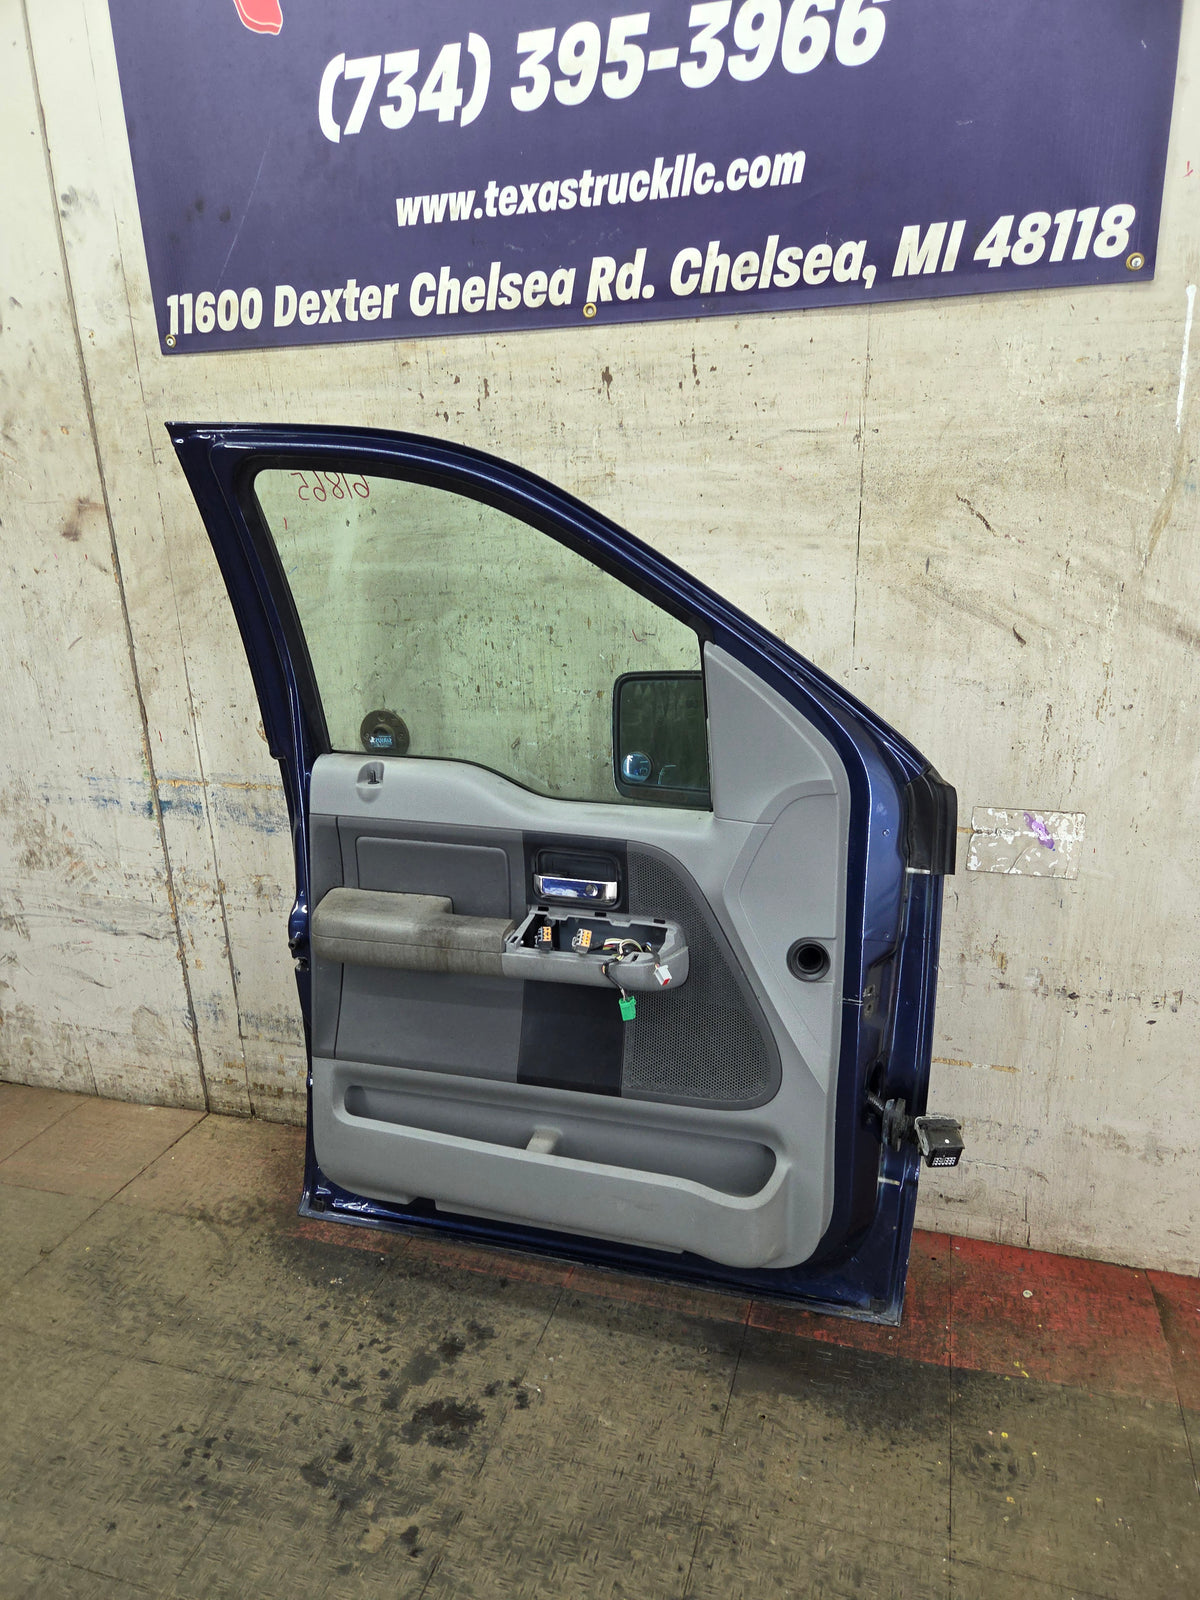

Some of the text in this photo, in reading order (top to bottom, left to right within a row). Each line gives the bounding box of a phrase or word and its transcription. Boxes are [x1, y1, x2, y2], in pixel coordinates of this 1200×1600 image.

[318, 0, 891, 143] (734) 395-3966
[396, 150, 806, 227] www.texastruckllc.com
[167, 203, 1136, 336] 11600 Dexter Chelsea Rd. Chelsea, MI 48118
